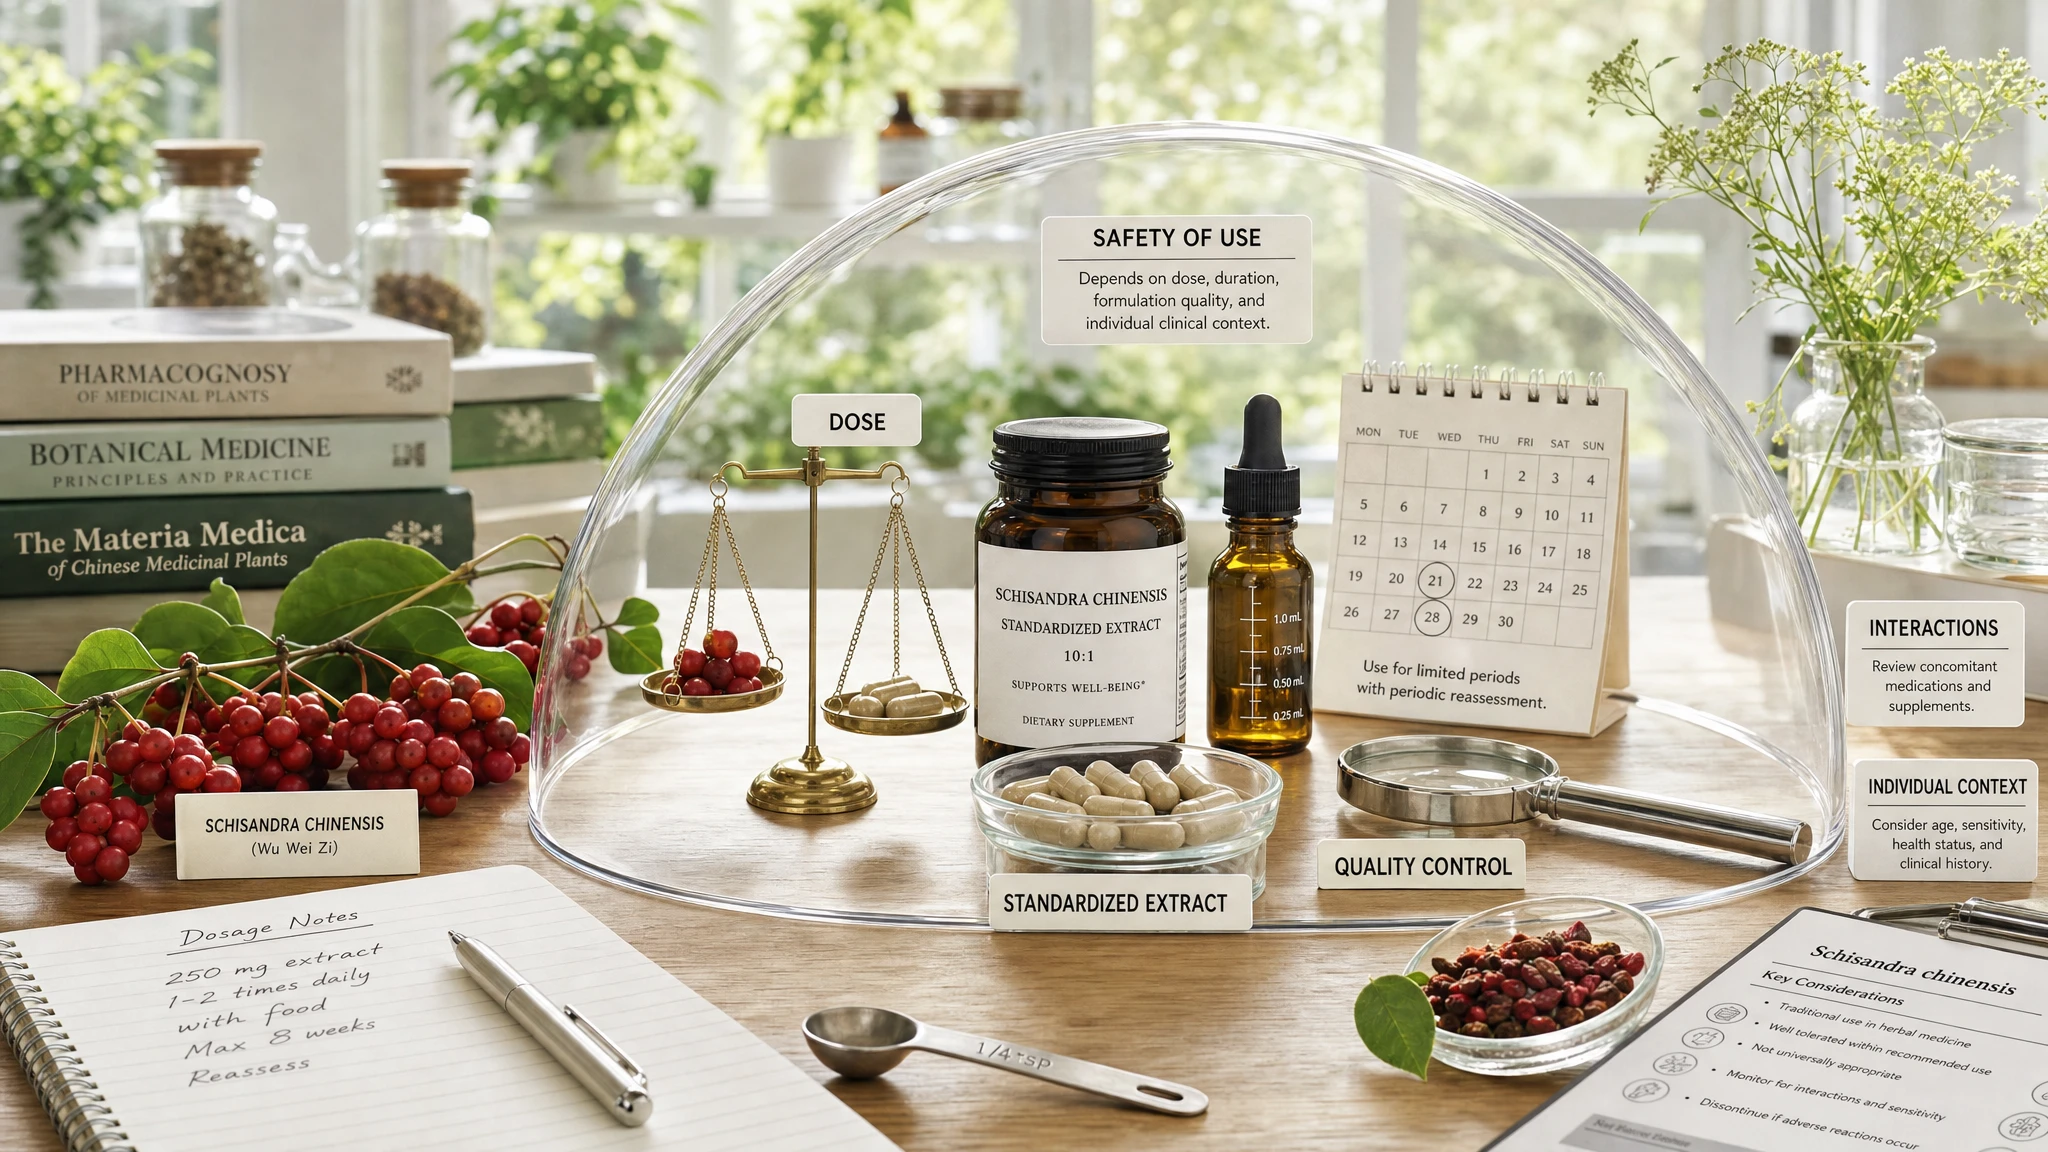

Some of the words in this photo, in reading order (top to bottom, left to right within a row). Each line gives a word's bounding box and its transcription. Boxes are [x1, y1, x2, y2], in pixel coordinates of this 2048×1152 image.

[1092, 228, 1175, 248] SAFETY
[1182, 228, 1213, 248] OF
[1220, 228, 1262, 248] USE
[1078, 271, 1144, 289] Depends
[1148, 273, 1167, 285] on
[1171, 270, 1210, 288] dose,
[1214, 270, 1280, 288] duration,
[1093, 293, 1176, 308] formulation
[1181, 293, 1233, 311] quality,
[1238, 293, 1265, 308] and
[1086, 315, 1155, 330] individual
[1158, 315, 1207, 330] clinical
[1212, 317, 1270, 330] context.
[58, 363, 292, 386] PHARMACOGNOSY
[77, 390, 98, 403] OF
[104, 390, 200, 403] MEDICINAL
[206, 389, 270, 403] PLANTS
[828, 412, 886, 431] DOSE
[1356, 426, 1381, 438] MON
[1398, 429, 1419, 440] TUE
[1437, 431, 1462, 443] WED
[1478, 434, 1500, 445] THU
[1517, 437, 1534, 447] FRI
[1550, 438, 1570, 450] SAT
[1582, 440, 1605, 451] SUN
[29, 440, 191, 467] BOTANICAL
[201, 435, 331, 461] MEDICINE
[52, 472, 168, 489] PRINCIPLES
[177, 471, 216, 486] AND
[225, 468, 313, 483] PRACTICE
[1483, 468, 1490, 480] 1
[1518, 470, 1526, 482] 2
[1551, 472, 1559, 484] 3
[1586, 474, 1595, 486] 4
[1359, 498, 1368, 510] 5
[1400, 500, 1408, 513] 6
[1440, 503, 1448, 515] 7
[1479, 506, 1487, 517] 8
[1514, 507, 1523, 519] 9
[1544, 509, 1559, 521] 10
[1580, 512, 1594, 524] 11
[14, 530, 65, 556] The
[73, 522, 190, 554] Materia
[200, 518, 307, 547] Medica
[1352, 534, 1367, 546] 12
[1393, 536, 1408, 549] 13
[1432, 539, 1447, 551] 14
[1472, 541, 1487, 553] 15
[1508, 543, 1522, 555] 16
[1542, 545, 1556, 558] 17
[1577, 548, 1591, 560] 18
[47, 558, 68, 582] of
[71, 556, 140, 576] Chinese
[145, 553, 229, 574] Medicinal
[234, 550, 288, 569] Plants
[1349, 570, 1363, 582] 19
[1388, 573, 1405, 585] 20
[1428, 575, 1443, 587] 21
[1467, 577, 1483, 589] 22
[1503, 580, 1519, 592] 23
[1537, 582, 1553, 594] 24
[1572, 584, 1588, 596] 25
[995, 587, 1089, 607] SCHISANDRA
[1092, 587, 1168, 607] CHINENSIS
[1000, 617, 1102, 635] STANDARDIZED
[1105, 617, 1162, 635] EXTRACT
[1274, 613, 1288, 624] 1.0
[1289, 611, 1302, 623] mL
[1343, 606, 1359, 619] 26
[1384, 608, 1400, 621] 27
[1424, 611, 1440, 624] 28
[1462, 613, 1478, 626] 29
[1497, 615, 1514, 628] 30
[1870, 618, 1999, 637] INTERACTIONS
[1063, 649, 1094, 663] 10:1
[1273, 645, 1292, 656] 0.75
[1293, 643, 1305, 654] mL
[1363, 659, 1389, 674] Use
[1392, 661, 1413, 677] for
[1416, 663, 1465, 680] limited
[1469, 668, 1521, 686] periods
[1872, 660, 1916, 673] Review
[1920, 660, 1997, 673] concomitant
[1011, 679, 1067, 693] SUPPORTS
[1273, 677, 1292, 689] 0.50
[1293, 675, 1305, 686] mL
[1885, 679, 1963, 692] medications
[1967, 679, 1991, 692] and
[1356, 682, 1385, 696] with
[1389, 683, 1446, 702] periodic
[1450, 691, 1547, 709] reassessment.
[1273, 710, 1291, 721] 0.25
[1293, 708, 1304, 718] mL
[1889, 699, 1974, 715] supplements.
[1022, 715, 1065, 727] DIETARY
[1068, 716, 1135, 728] SUPPLEMENT
[1868, 778, 1953, 795] INDIVIDUAL
[1957, 778, 2027, 795] CONTEXT
[205, 817, 300, 833] SCHISANDRA
[304, 815, 384, 832] CHINENSIS
[1872, 818, 1929, 831] Consider
[1931, 821, 1958, 834] age,
[1962, 818, 2026, 835] sensitivity,
[251, 842, 280, 857] (Wu
[286, 842, 312, 855] Wei
[318, 840, 338, 856] Zi)
[1892, 838, 1931, 850] health
[1934, 839, 1975, 852] status,
[1979, 838, 2003, 850] and
[1334, 856, 1416, 878] QUALITY
[1421, 856, 1512, 876] CONTROL
[1900, 857, 1941, 870] clinical
[1945, 857, 1992, 872] history.
[1003, 893, 1140, 914] STANDARDIZED
[1145, 892, 1227, 913] EXTRACT
[179, 924, 273, 947] Dosage
[289, 911, 359, 929] Notes
[165, 967, 221, 985] 250
[234, 964, 268, 979] mg
[285, 942, 383, 968] extract
[1810, 945, 1918, 977] Schisandra
[1921, 968, 2017, 996] chinensis
[168, 991, 217, 1009] 1-2
[233, 980, 298, 999] times
[312, 967, 370, 987] daily
[1762, 970, 1793, 985] Key
[1795, 977, 1905, 1006] Considerations
[178, 1012, 246, 1033] with
[264, 997, 327, 1026] food
[1779, 1002, 1841, 1022] Traditional
[1842, 1015, 1863, 1026] use
[1865, 1020, 1877, 1030] in
[1878, 1022, 1917, 1038] herbal
[1918, 1031, 1972, 1049] medicine
[184, 1041, 247, 1060] Max
[269, 1028, 291, 1045] 8
[306, 1018, 376, 1040] weeks
[1769, 1022, 1794, 1034] Well
[1795, 1029, 1848, 1046] tolerated
[1848, 1040, 1883, 1054] within
[1885, 1048, 1970, 1071] recommended
[1971, 1065, 1993, 1076] use
[976, 1042, 1012, 1061] 1/4
[1751, 1043, 1775, 1054] Not
[1777, 1049, 1836, 1068] universally
[1837, 1061, 1902, 1081] appropriate
[188, 1059, 311, 1087] Reassess
[1726, 1069, 1774, 1086] Monitor
[1775, 1079, 1794, 1090] for
[1793, 1083, 1862, 1105] interactions
[1863, 1099, 1887, 1111] and
[1888, 1104, 1947, 1123] sensitivity
[1771, 1113, 1782, 1122] if
[1782, 1117, 1828, 1132] adverse
[1829, 1126, 1884, 1144] reactions
[1885, 1138, 1920, 1151] occur
